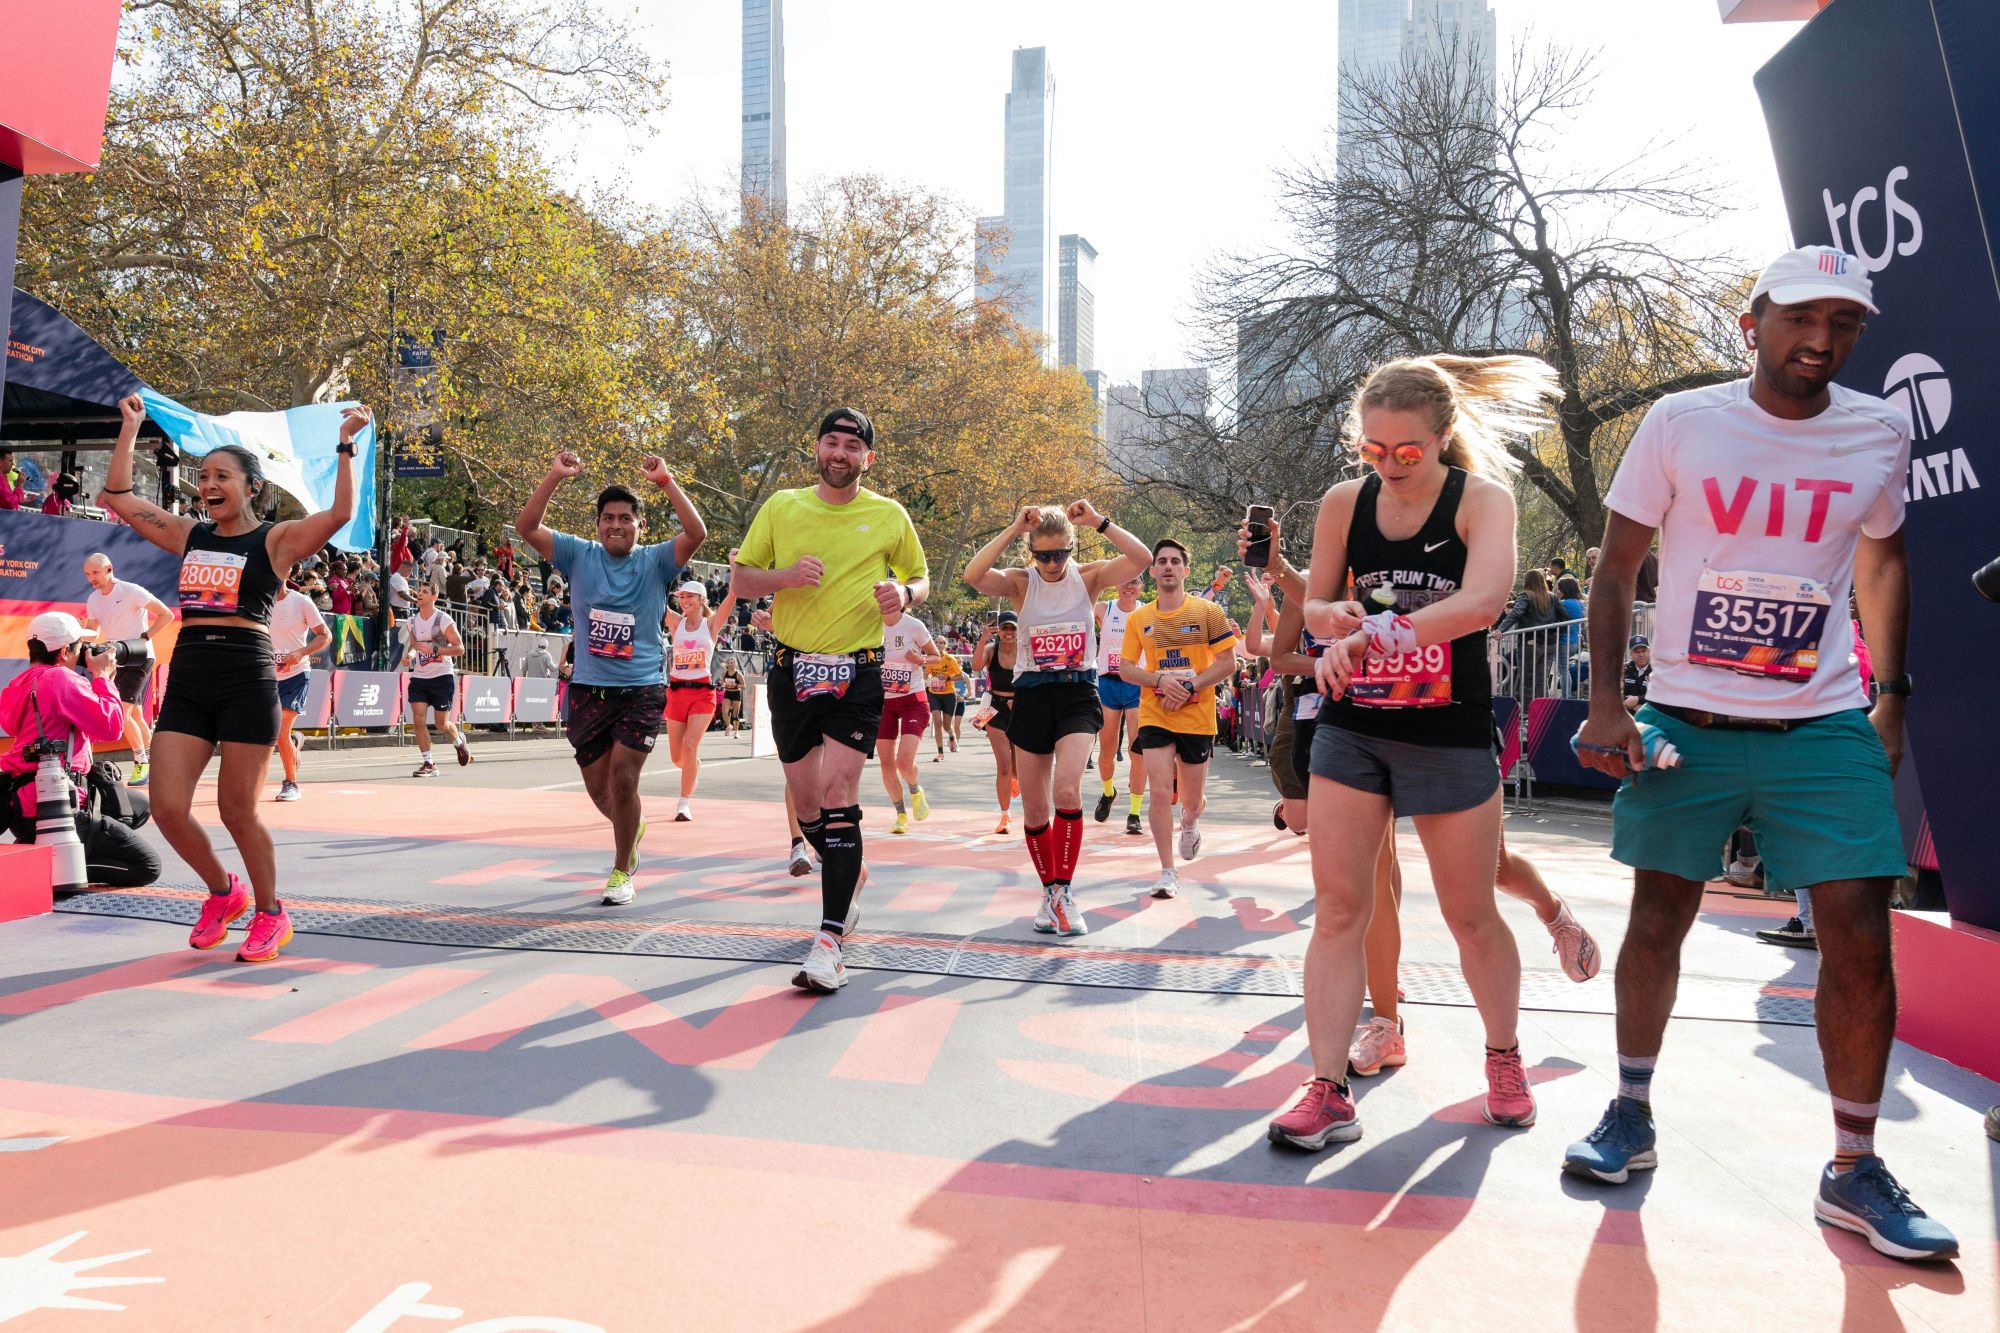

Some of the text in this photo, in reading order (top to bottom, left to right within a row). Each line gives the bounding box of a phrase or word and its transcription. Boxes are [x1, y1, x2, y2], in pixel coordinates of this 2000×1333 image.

[6, 349, 34, 363] RATHON
[12, 341, 46, 357] YORK CITY
[1702, 476, 1854, 544] VIT
[6, 560, 39, 570] YORK CITY
[0, 569, 27, 578] RATHON
[180, 565, 238, 588] 28009
[1392, 570, 1424, 586] RUN
[1426, 573, 1456, 592] TWO
[1705, 596, 1818, 638] 35517
[590, 621, 631, 641] 25179
[1713, 632, 1721, 640] 3
[1765, 638, 1774, 646] E
[1035, 634, 1082, 653] 26210
[1166, 649, 1181, 658] ICE
[1366, 644, 1444, 674] 9939
[1159, 657, 1190, 669] POWER
[796, 662, 851, 681] 22919
[881, 669, 910, 681] 20859
[364, 707, 384, 716] balance
